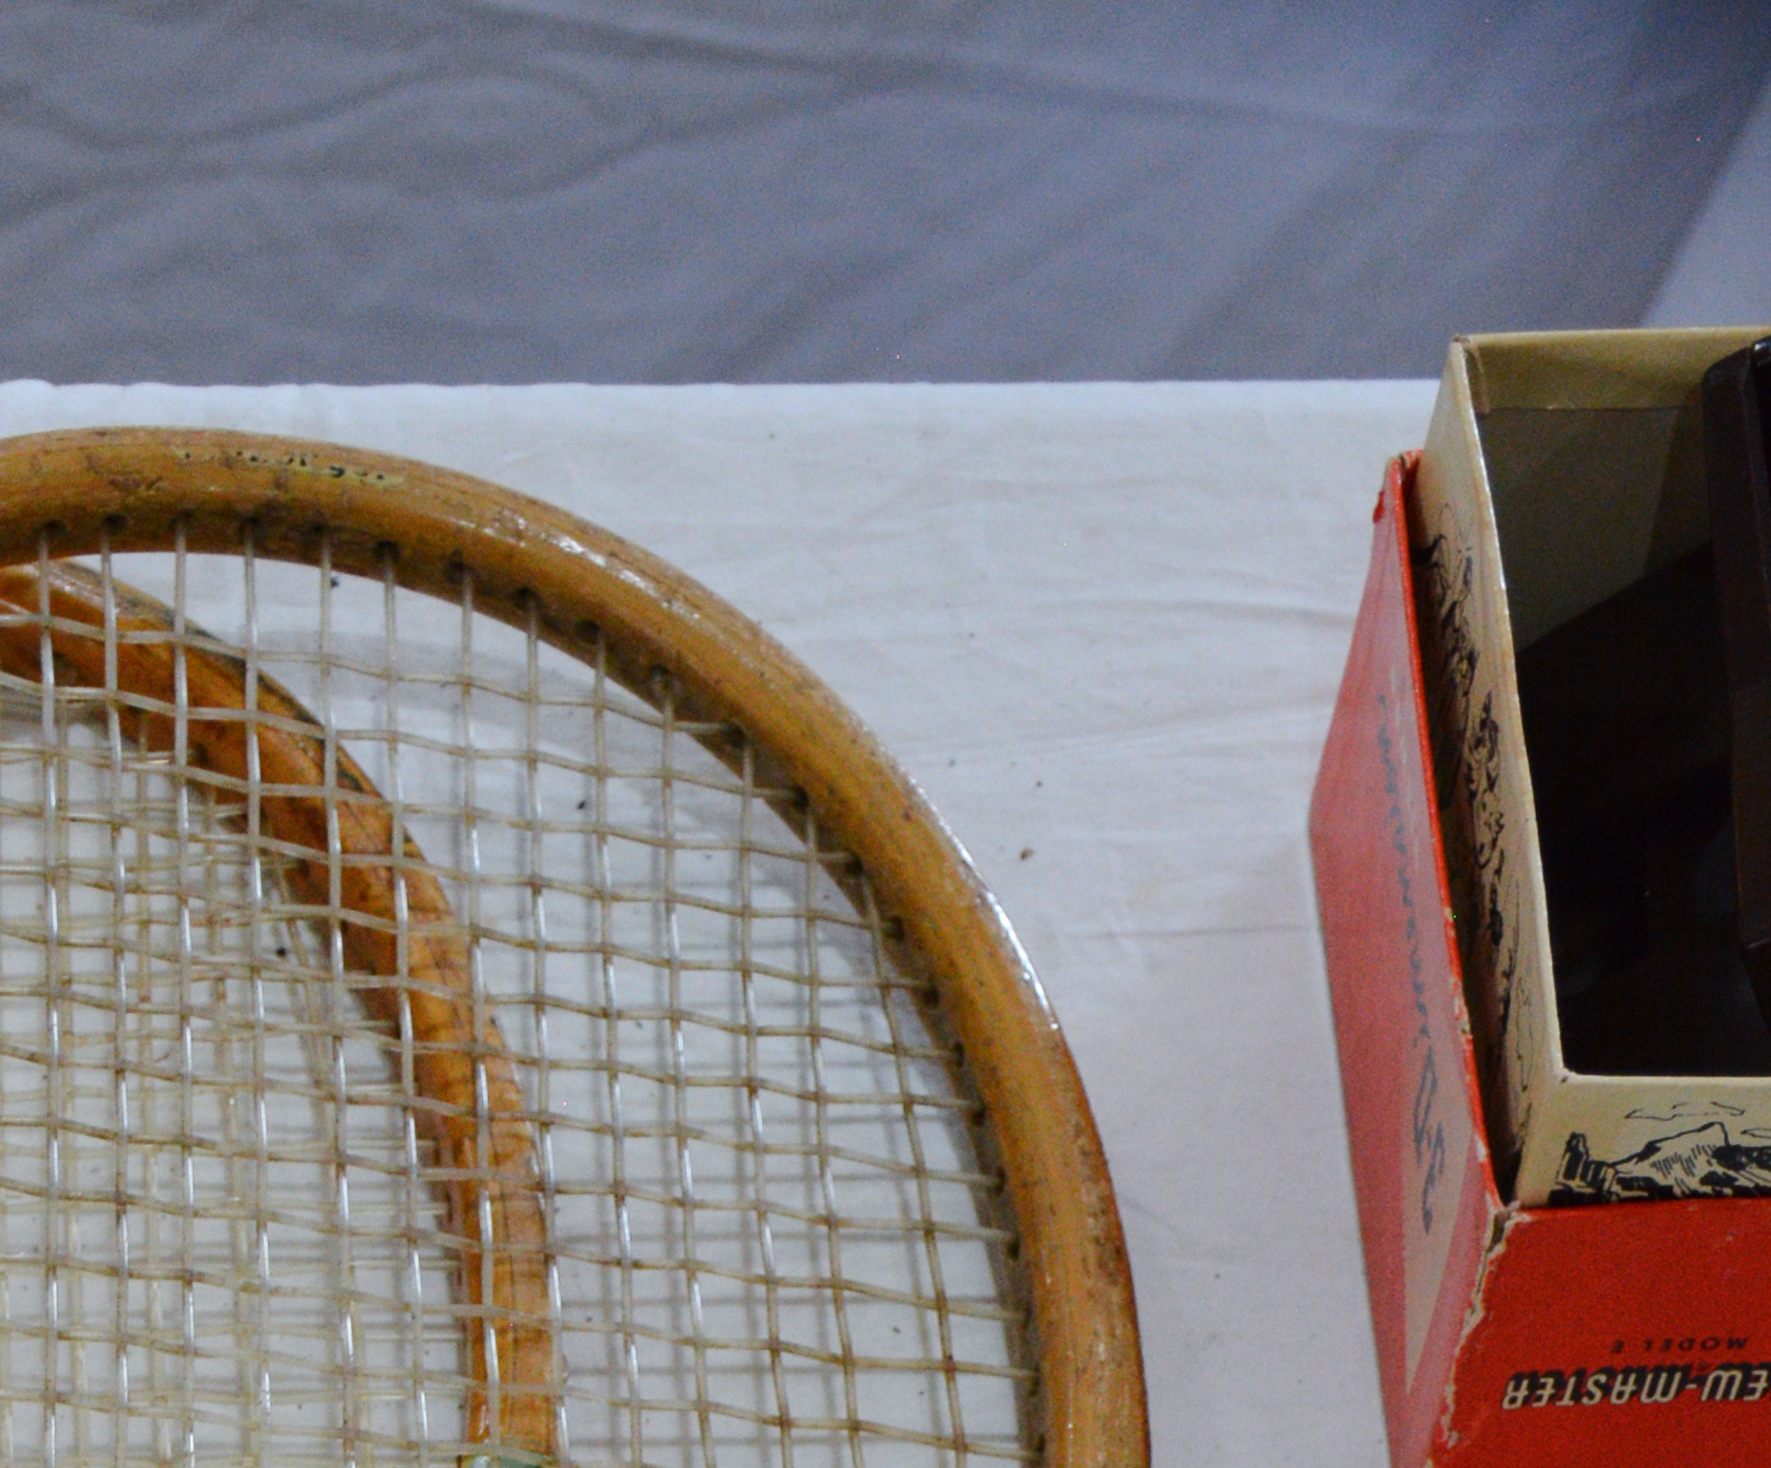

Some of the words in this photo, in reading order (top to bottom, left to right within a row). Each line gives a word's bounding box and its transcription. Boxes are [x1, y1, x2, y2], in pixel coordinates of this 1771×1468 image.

[1610, 1340, 1625, 1354] E
[1644, 1337, 1747, 1352] MODEL
[1502, 1362, 1771, 1409] EW-MASTER
